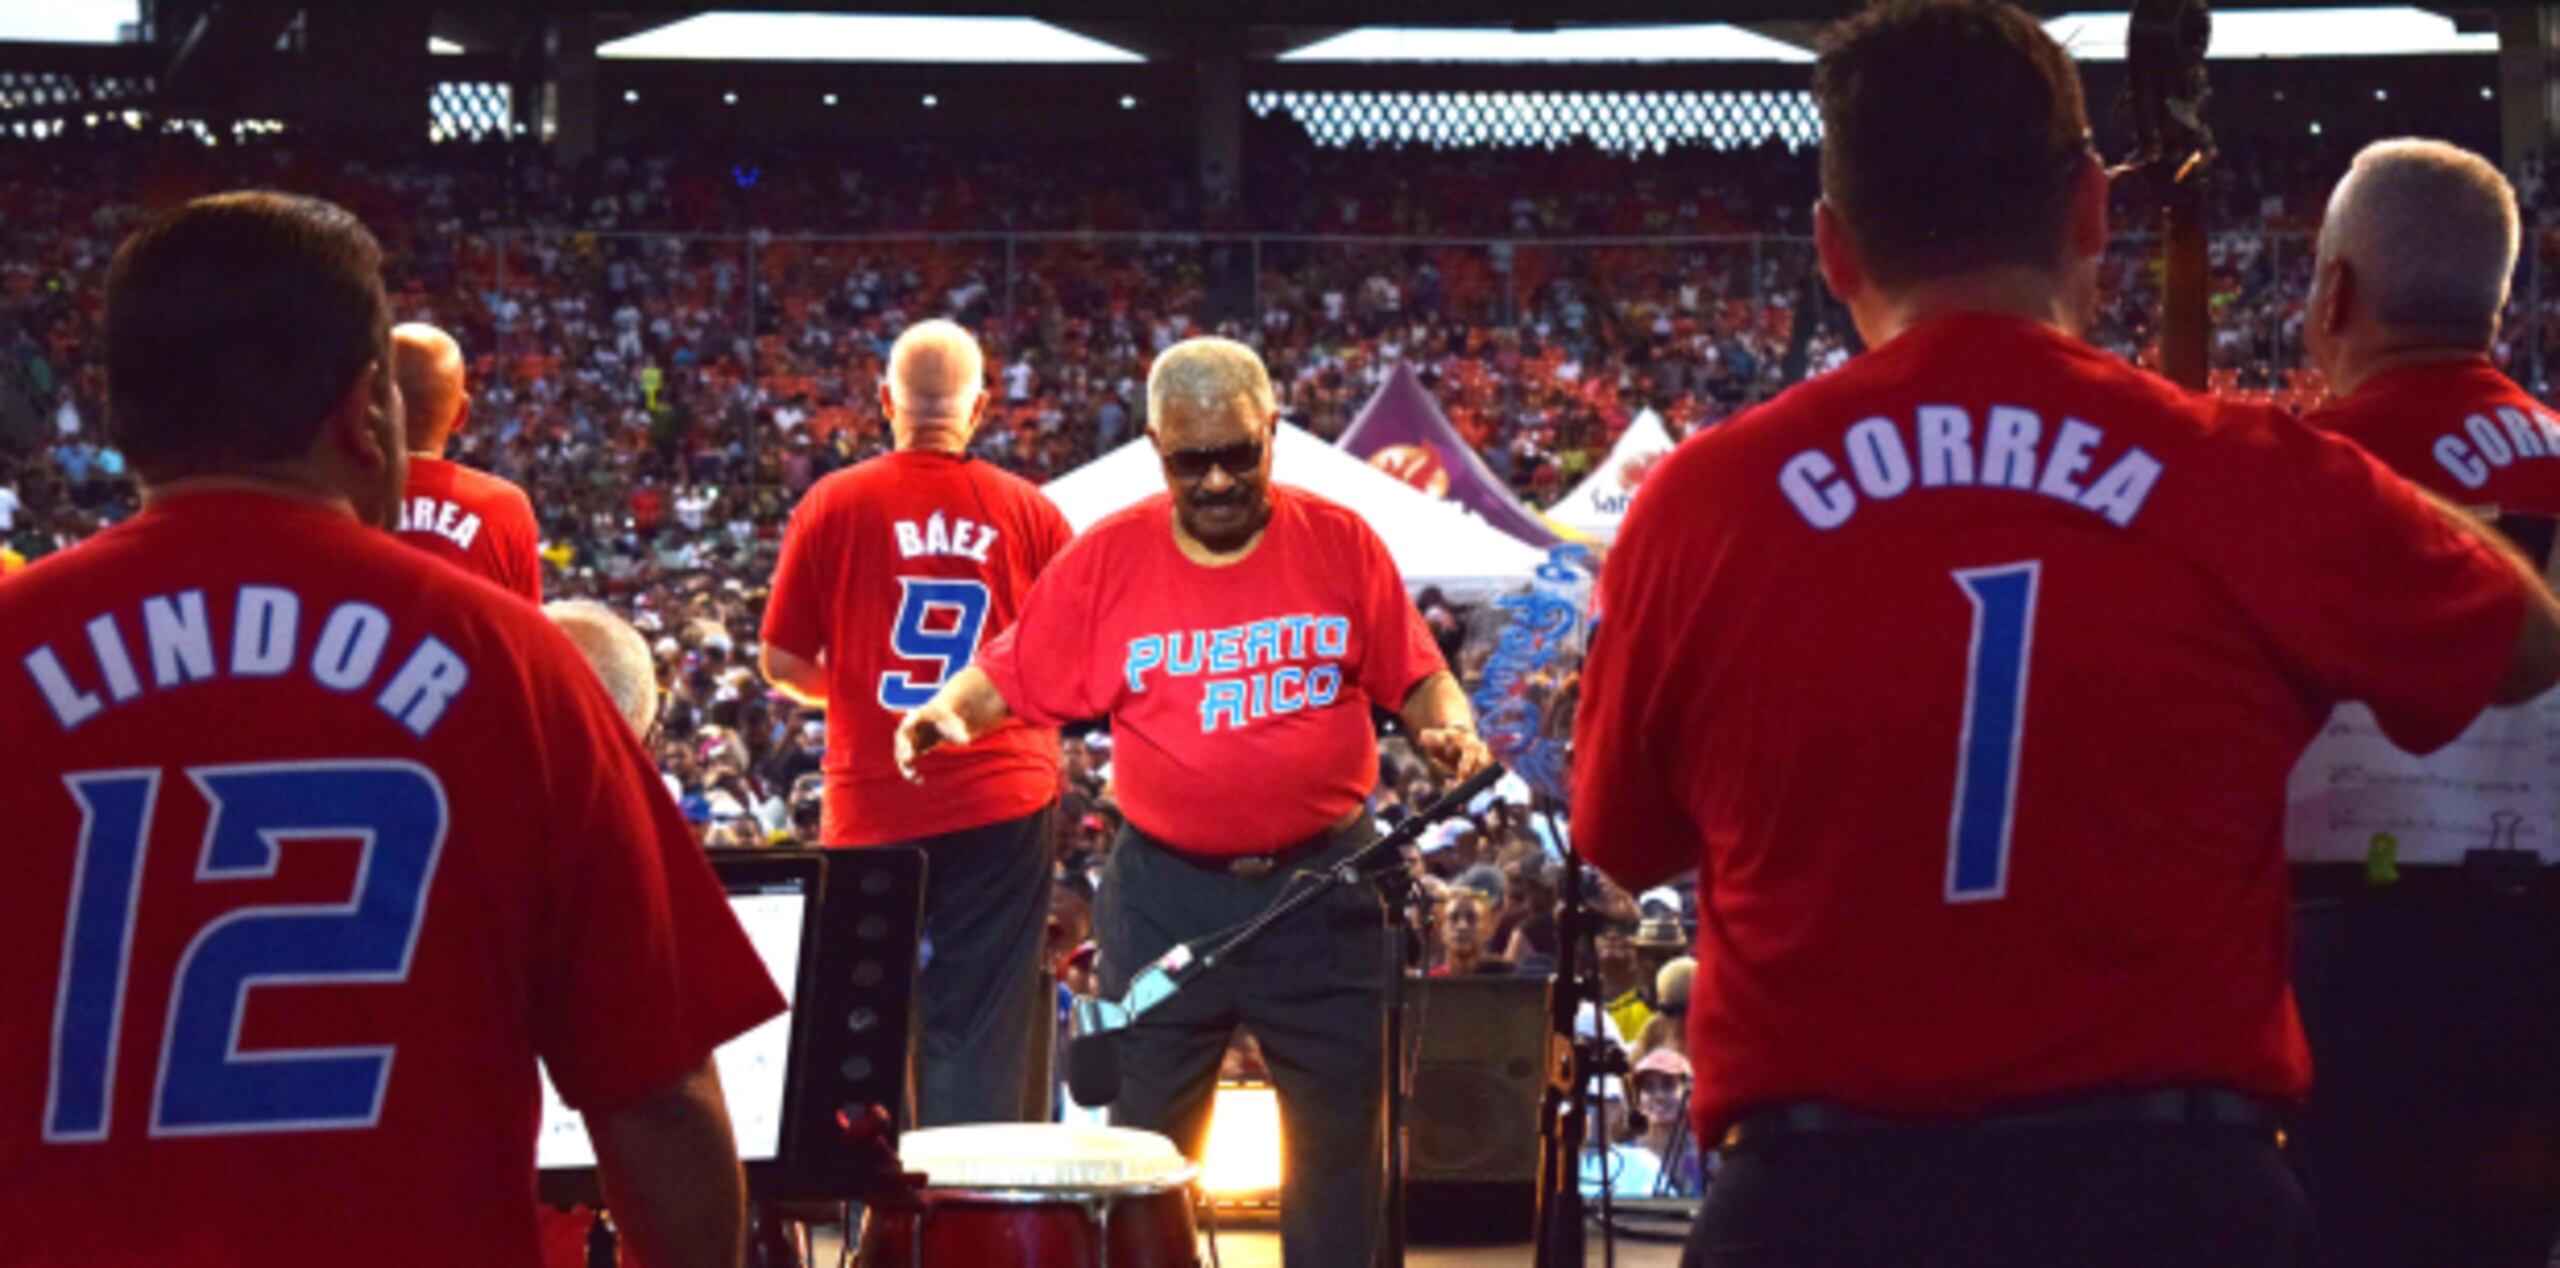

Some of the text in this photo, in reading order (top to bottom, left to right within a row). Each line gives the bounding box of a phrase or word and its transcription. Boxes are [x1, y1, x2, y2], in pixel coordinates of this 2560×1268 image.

[1778, 403, 2164, 530] CORREA
[893, 509, 999, 565] BÁEZ
[22, 583, 470, 739] LINDOR
[876, 572, 992, 711] 9
[1126, 612, 1351, 694] PUERTO
[1199, 662, 1343, 735] RICO
[1945, 558, 2043, 905] 1
[42, 757, 450, 1143] 12
